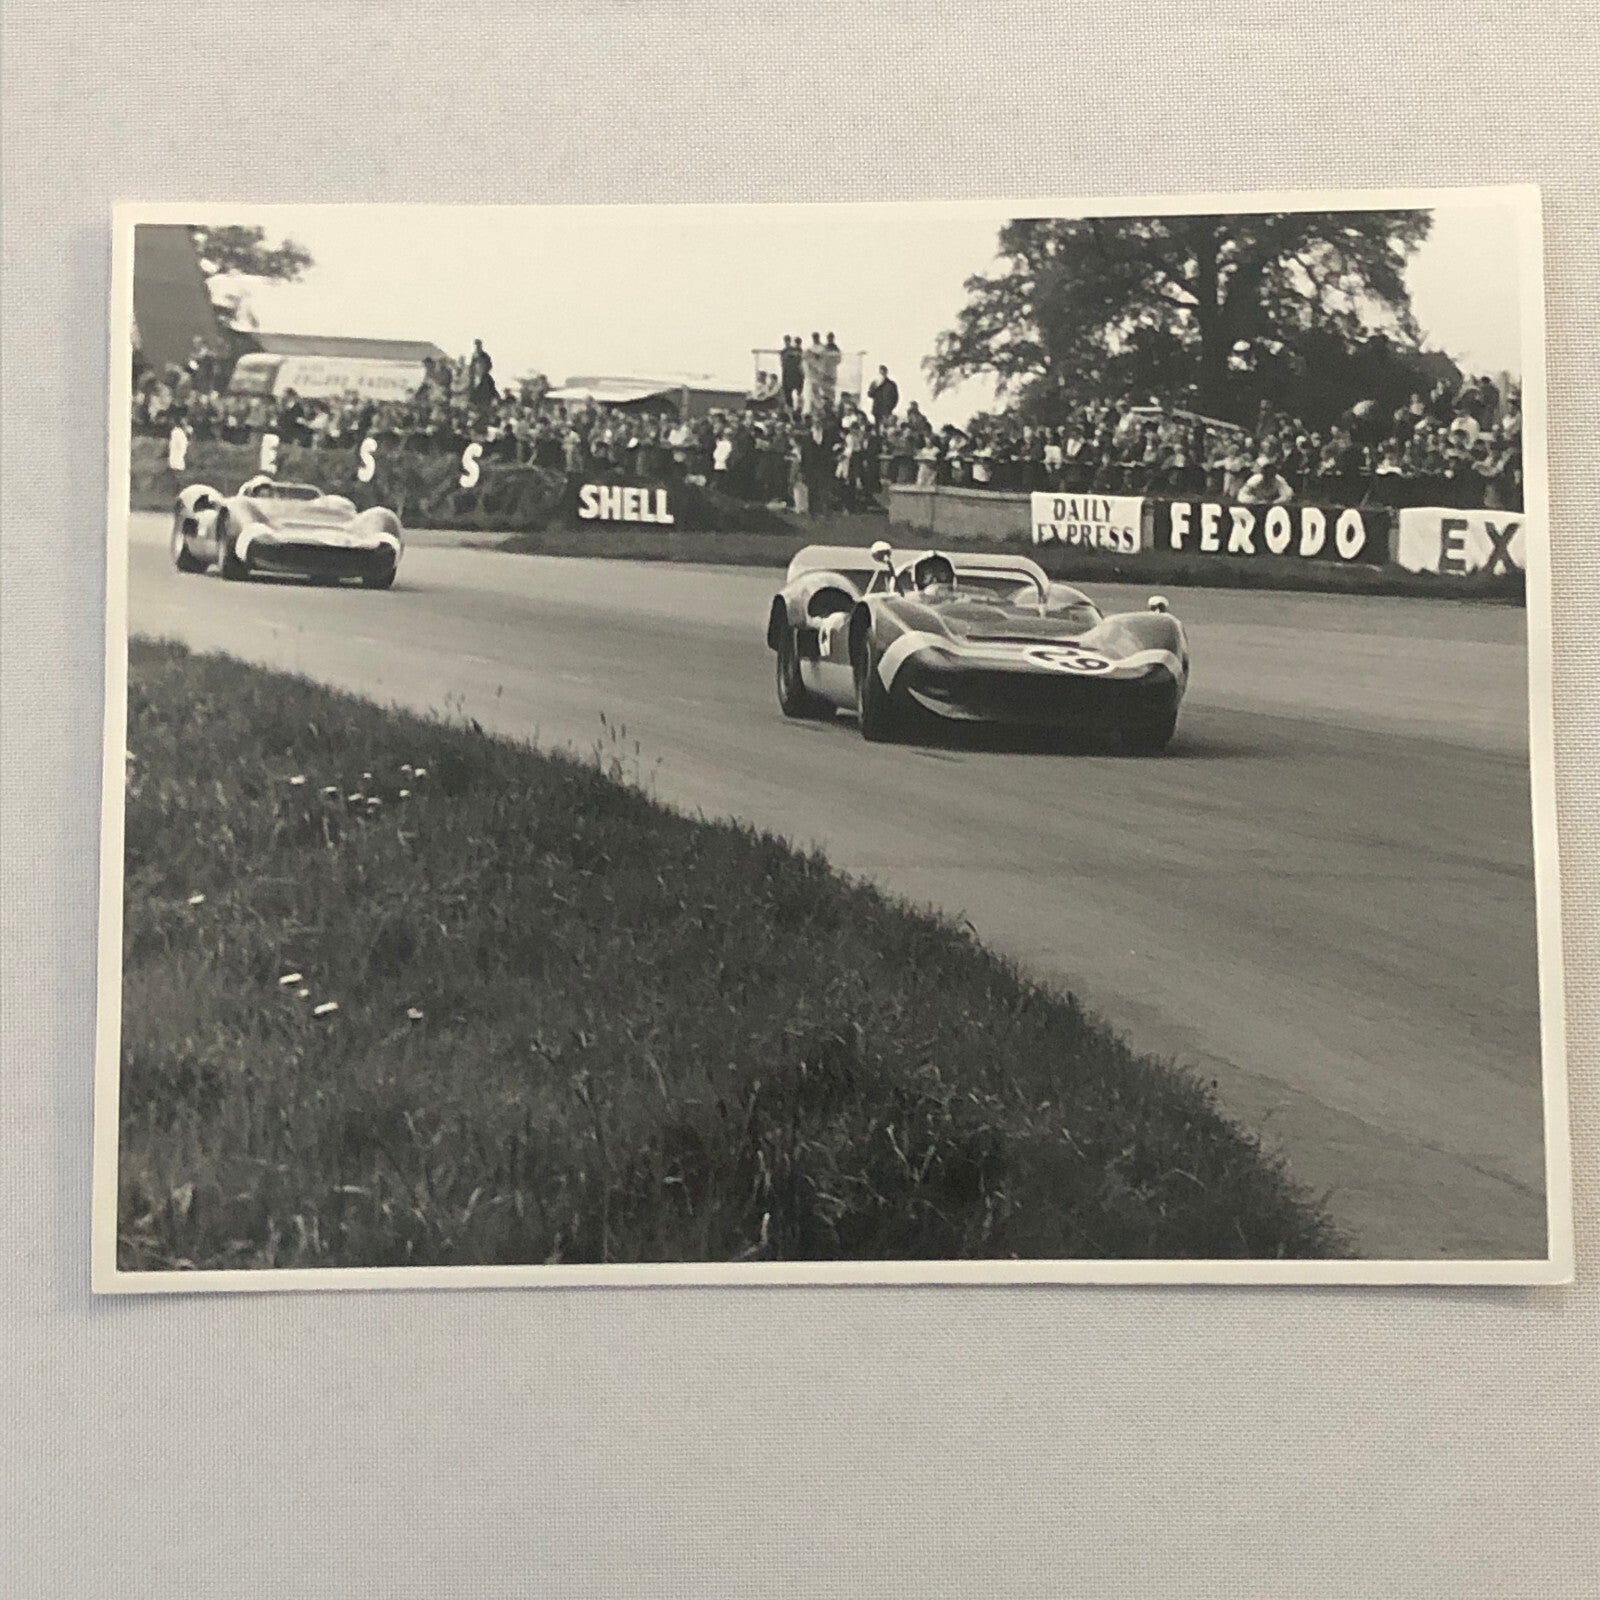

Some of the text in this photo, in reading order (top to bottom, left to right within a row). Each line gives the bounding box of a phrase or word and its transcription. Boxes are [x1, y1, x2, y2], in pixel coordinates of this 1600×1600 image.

[578, 484, 674, 524] SHELL
[1053, 498, 1111, 523] DAILY
[1037, 523, 1135, 552] EXPRESS
[1170, 501, 1366, 559] FERODO
[1438, 518, 1520, 576] EX
